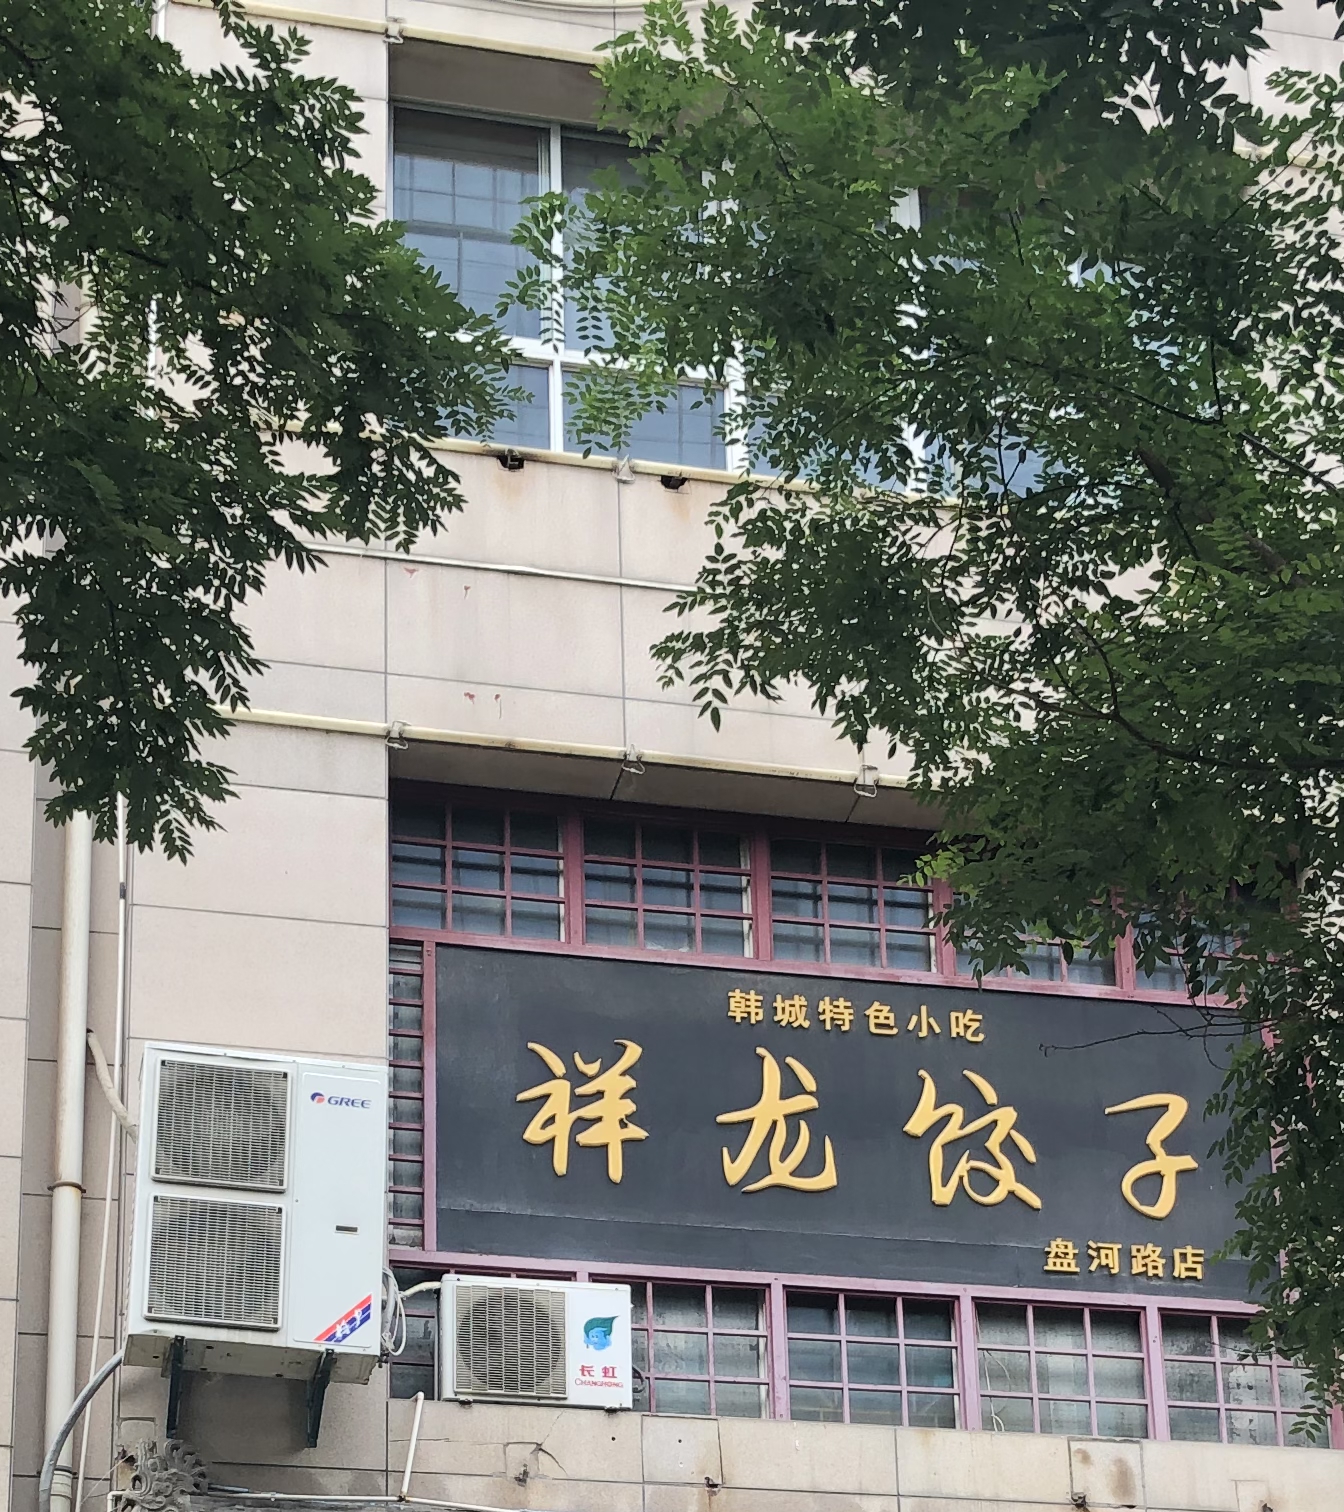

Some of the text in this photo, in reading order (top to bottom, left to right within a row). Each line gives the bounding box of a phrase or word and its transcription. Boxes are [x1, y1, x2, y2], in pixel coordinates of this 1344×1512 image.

[727, 988, 986, 1043] 韩城特色小吃
[327, 1095, 372, 1109] GREE
[515, 1038, 1200, 1220] 祥龙饺子
[1043, 1237, 1206, 1281] 盘河路店
[579, 1364, 618, 1379] 长虹
